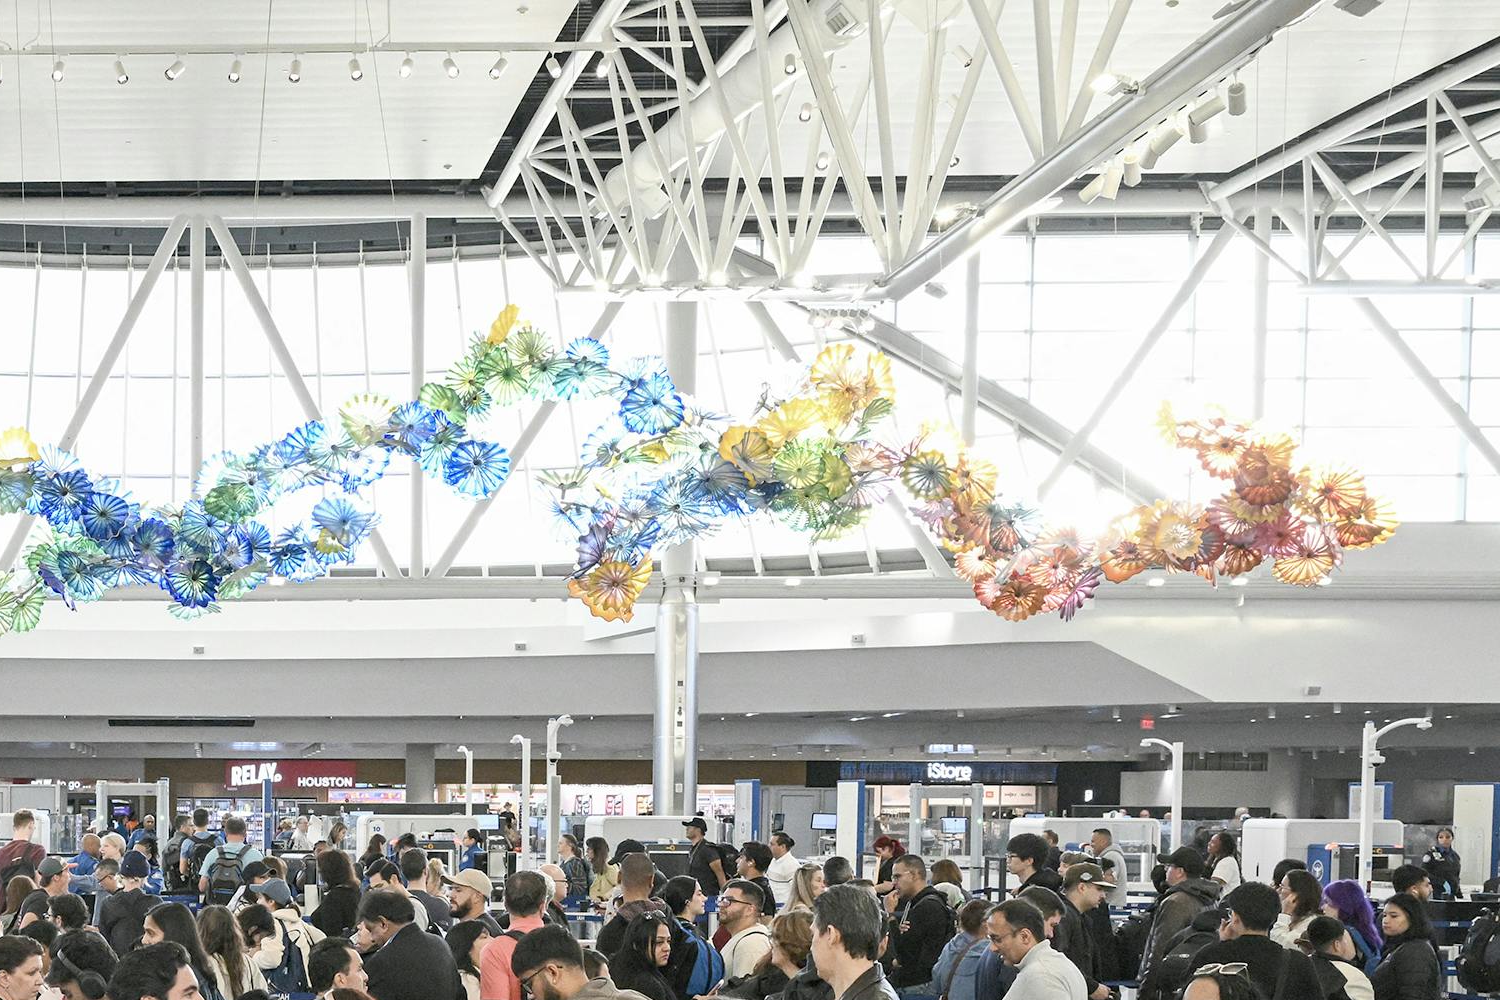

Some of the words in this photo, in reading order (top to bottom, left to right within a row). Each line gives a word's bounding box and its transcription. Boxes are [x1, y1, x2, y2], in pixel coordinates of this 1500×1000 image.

[231, 762, 277, 786] RELAY
[927, 762, 972, 778] iStore
[68, 781, 80, 790] go
[297, 776, 352, 787] HOUSTON
